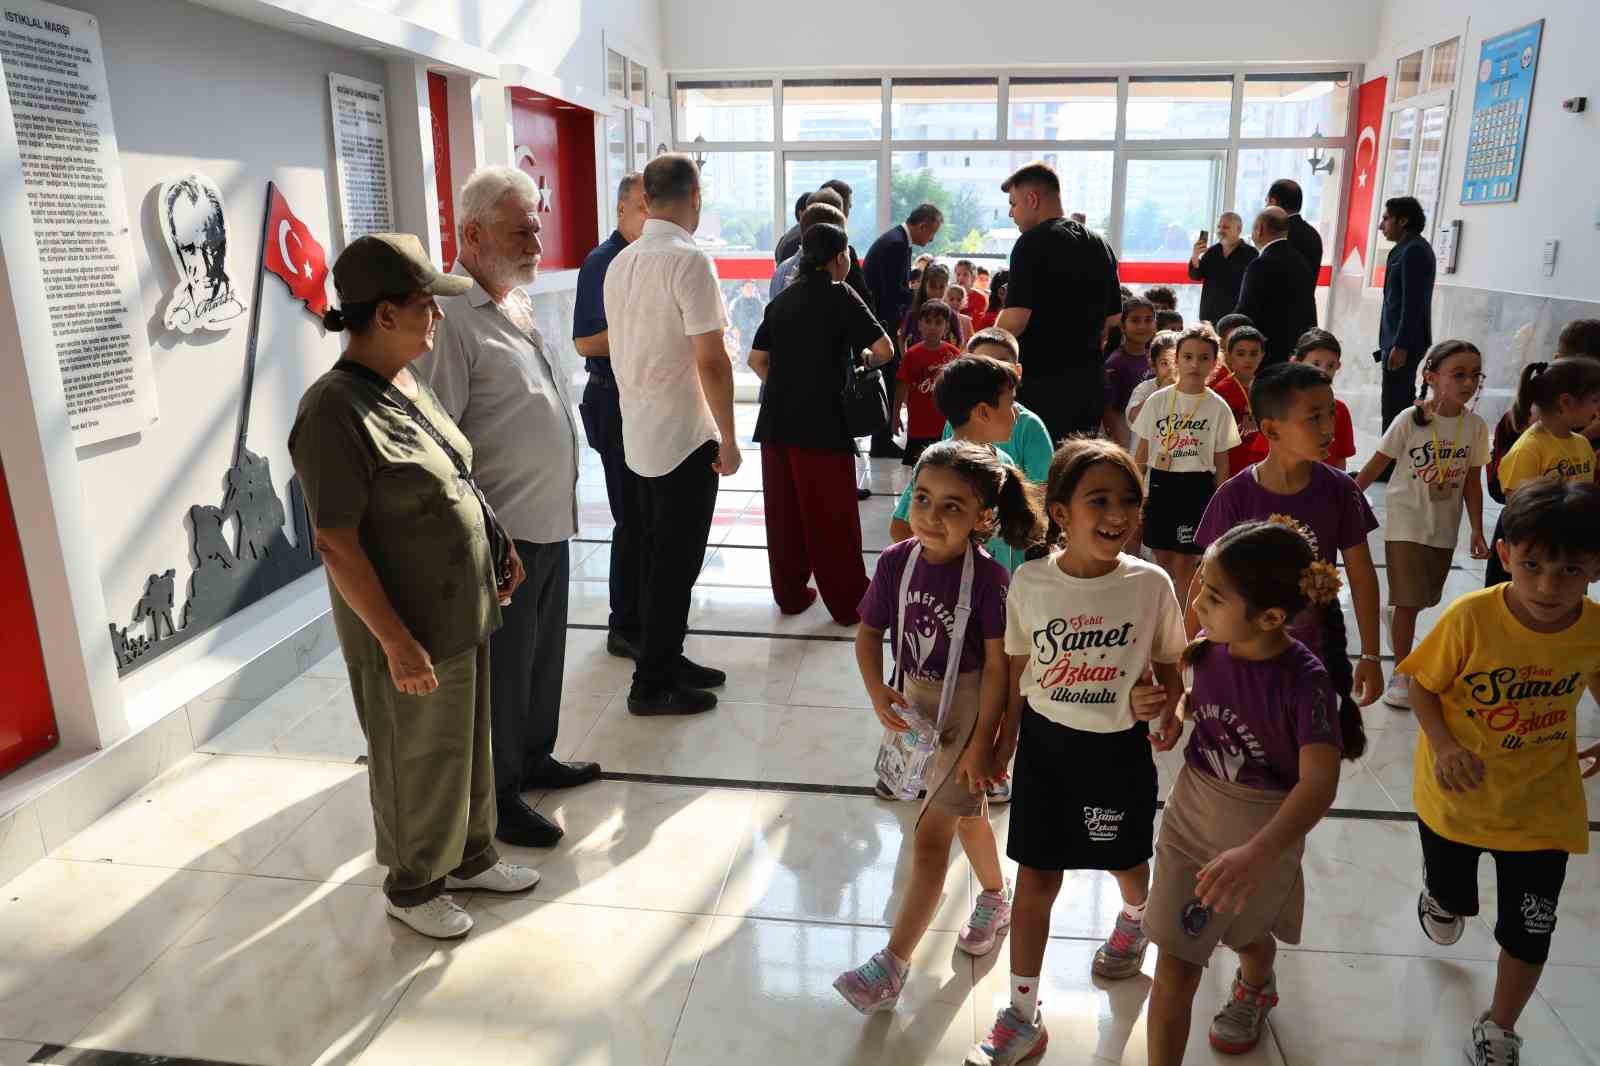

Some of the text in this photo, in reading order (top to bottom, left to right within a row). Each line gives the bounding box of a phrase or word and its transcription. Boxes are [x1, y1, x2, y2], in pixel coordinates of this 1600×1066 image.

[1033, 618, 1134, 665] Samet
[1040, 652, 1118, 688] Özkan
[1463, 667, 1581, 706] Samet
